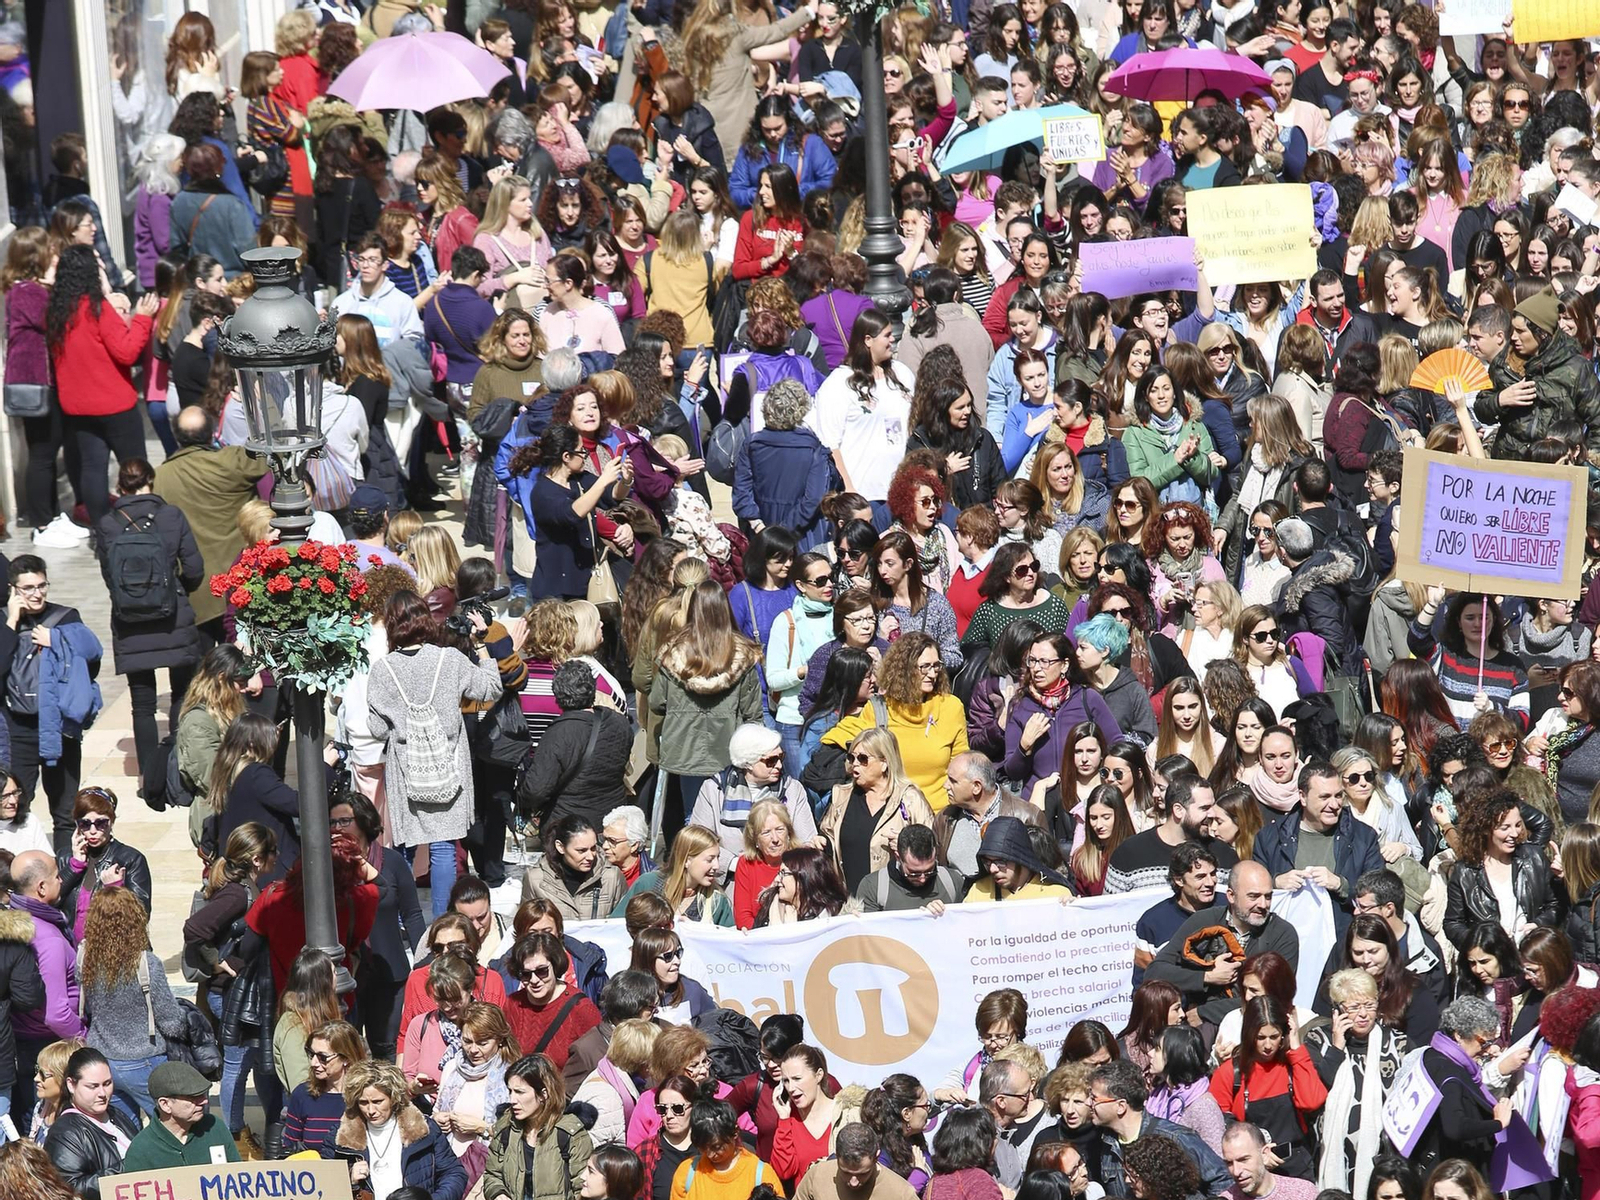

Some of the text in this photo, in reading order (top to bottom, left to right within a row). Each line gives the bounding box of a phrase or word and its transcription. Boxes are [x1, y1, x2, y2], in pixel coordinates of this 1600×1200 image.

[1052, 146, 1086, 160] UNIDAS
[1442, 474, 1556, 506] POR LA NOCHE
[1440, 505, 1478, 526] QUIERO
[1484, 515, 1501, 528] SER
[1435, 529, 1561, 567] NO VALIENTE
[968, 937, 988, 948] Por
[990, 936, 1002, 946] la
[1004, 931, 1058, 948] igualdad
[1060, 930, 1077, 941] de
[970, 952, 1052, 967] Combatiendo
[1055, 949, 1067, 959] la
[706, 961, 792, 975] SOCIACIÓN
[972, 973, 999, 985] Para
[1002, 971, 1045, 985] romper
[1048, 967, 1060, 978] el
[1062, 963, 1098, 977] techo
[1031, 985, 1075, 1000] brecha
[1078, 979, 1122, 993] salarial
[1027, 1002, 1089, 1019] violencias
[1046, 1023, 1062, 1033] de
